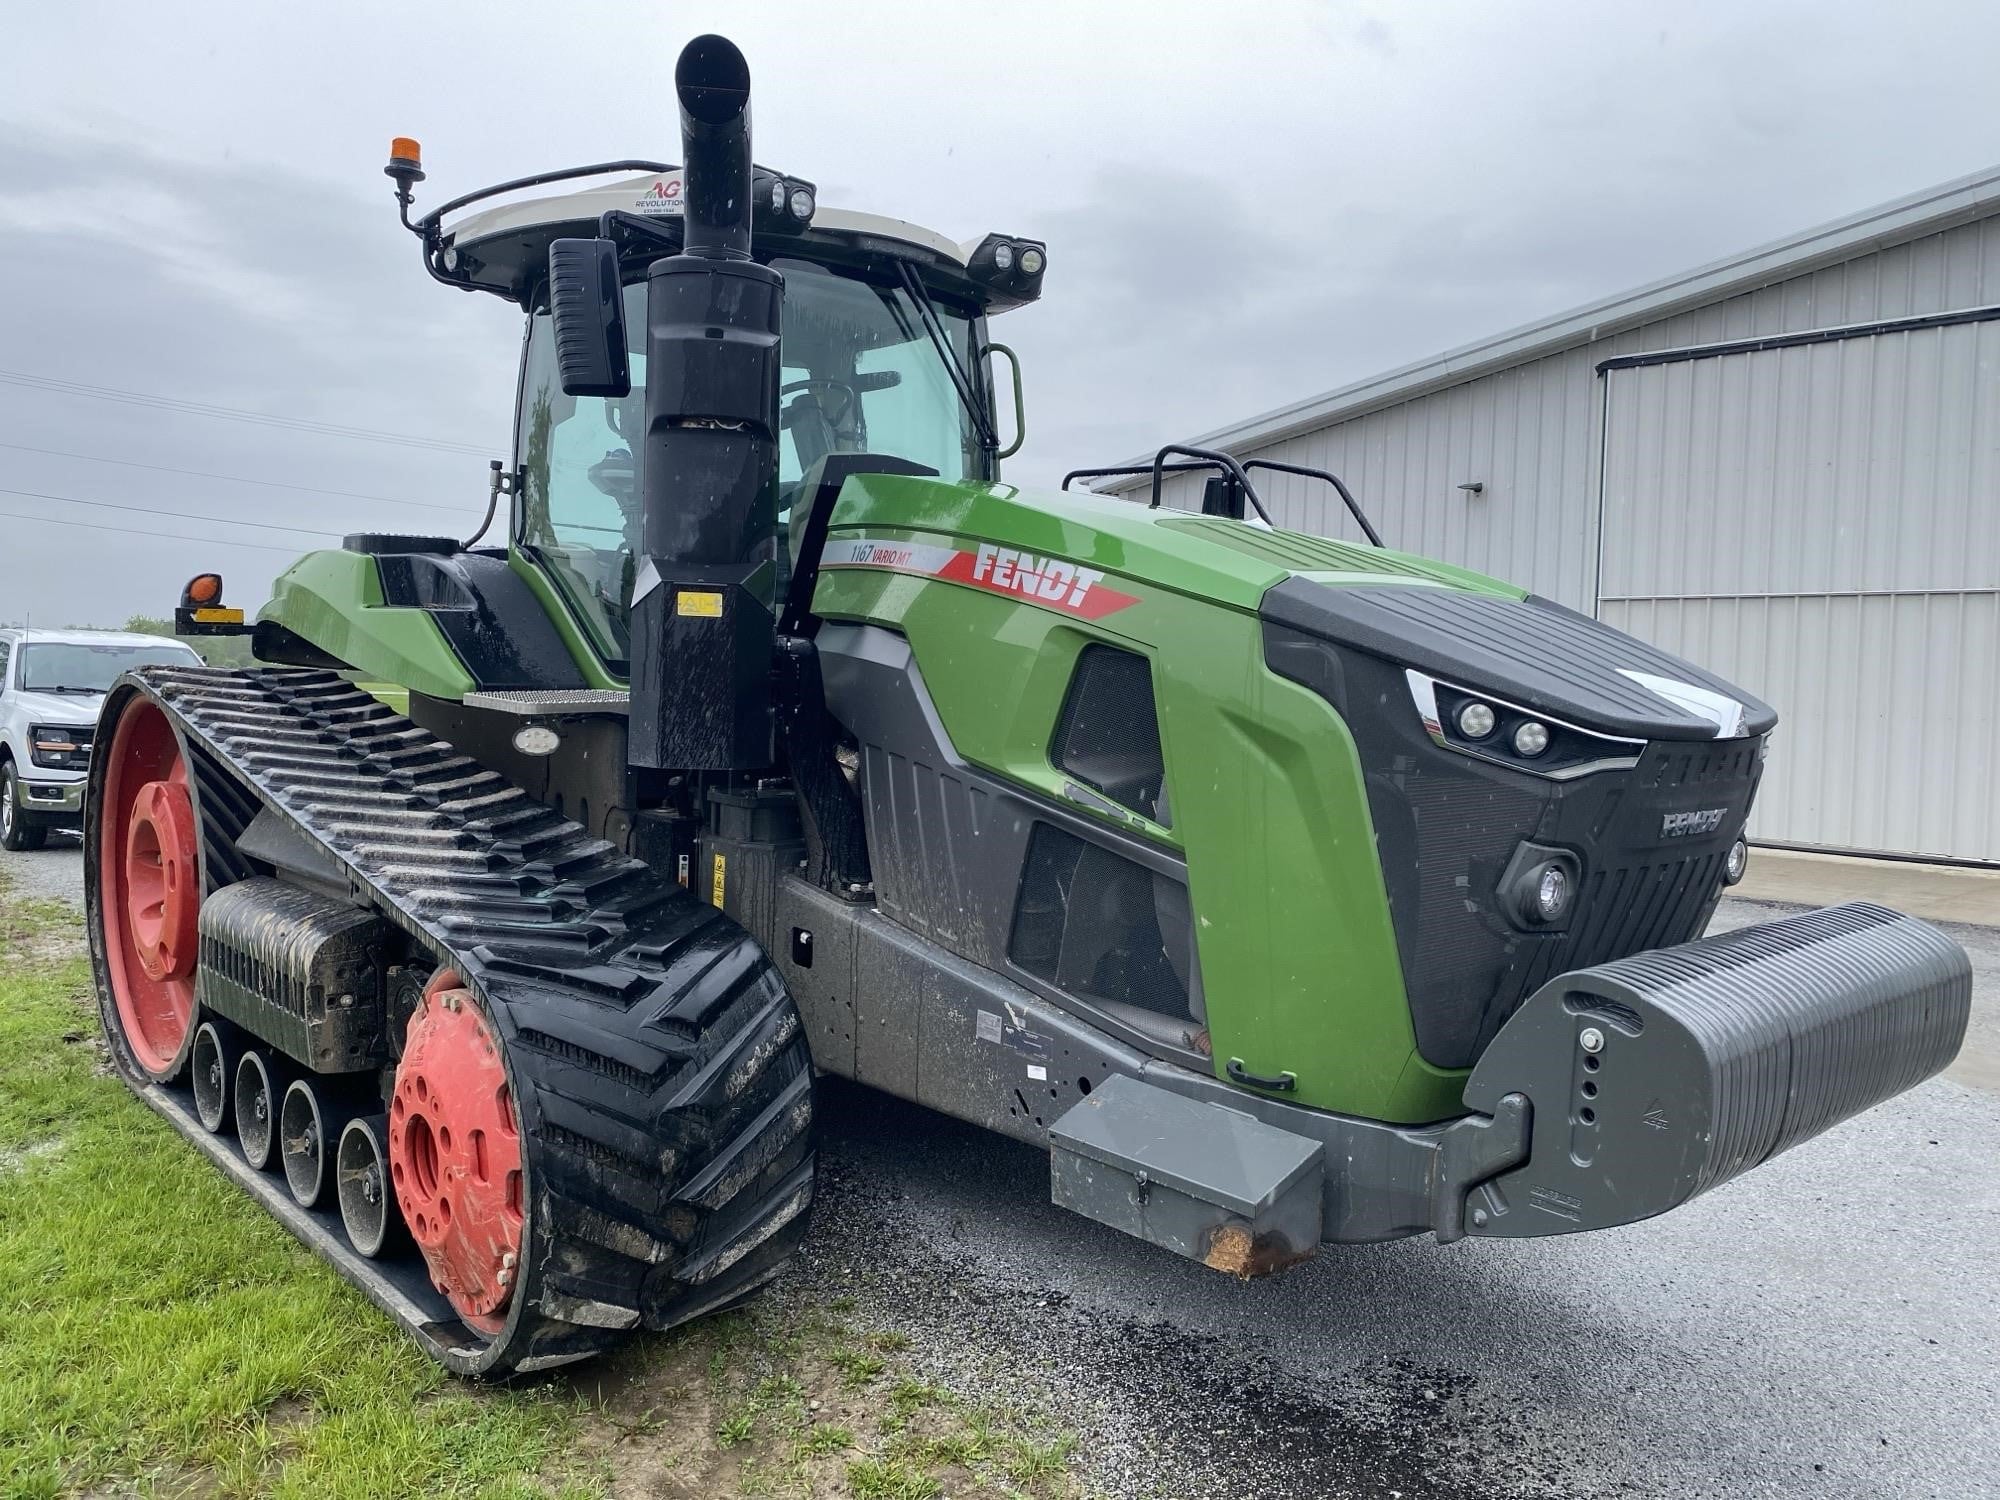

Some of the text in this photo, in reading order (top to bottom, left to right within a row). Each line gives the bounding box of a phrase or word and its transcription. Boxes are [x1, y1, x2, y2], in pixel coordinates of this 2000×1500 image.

[647, 181, 681, 199] AG
[635, 200, 685, 208] REVOLUTION
[850, 544, 912, 565] 1167 VARIO MT
[972, 542, 1106, 608] FENDT
[1660, 808, 1728, 837] FENDT
